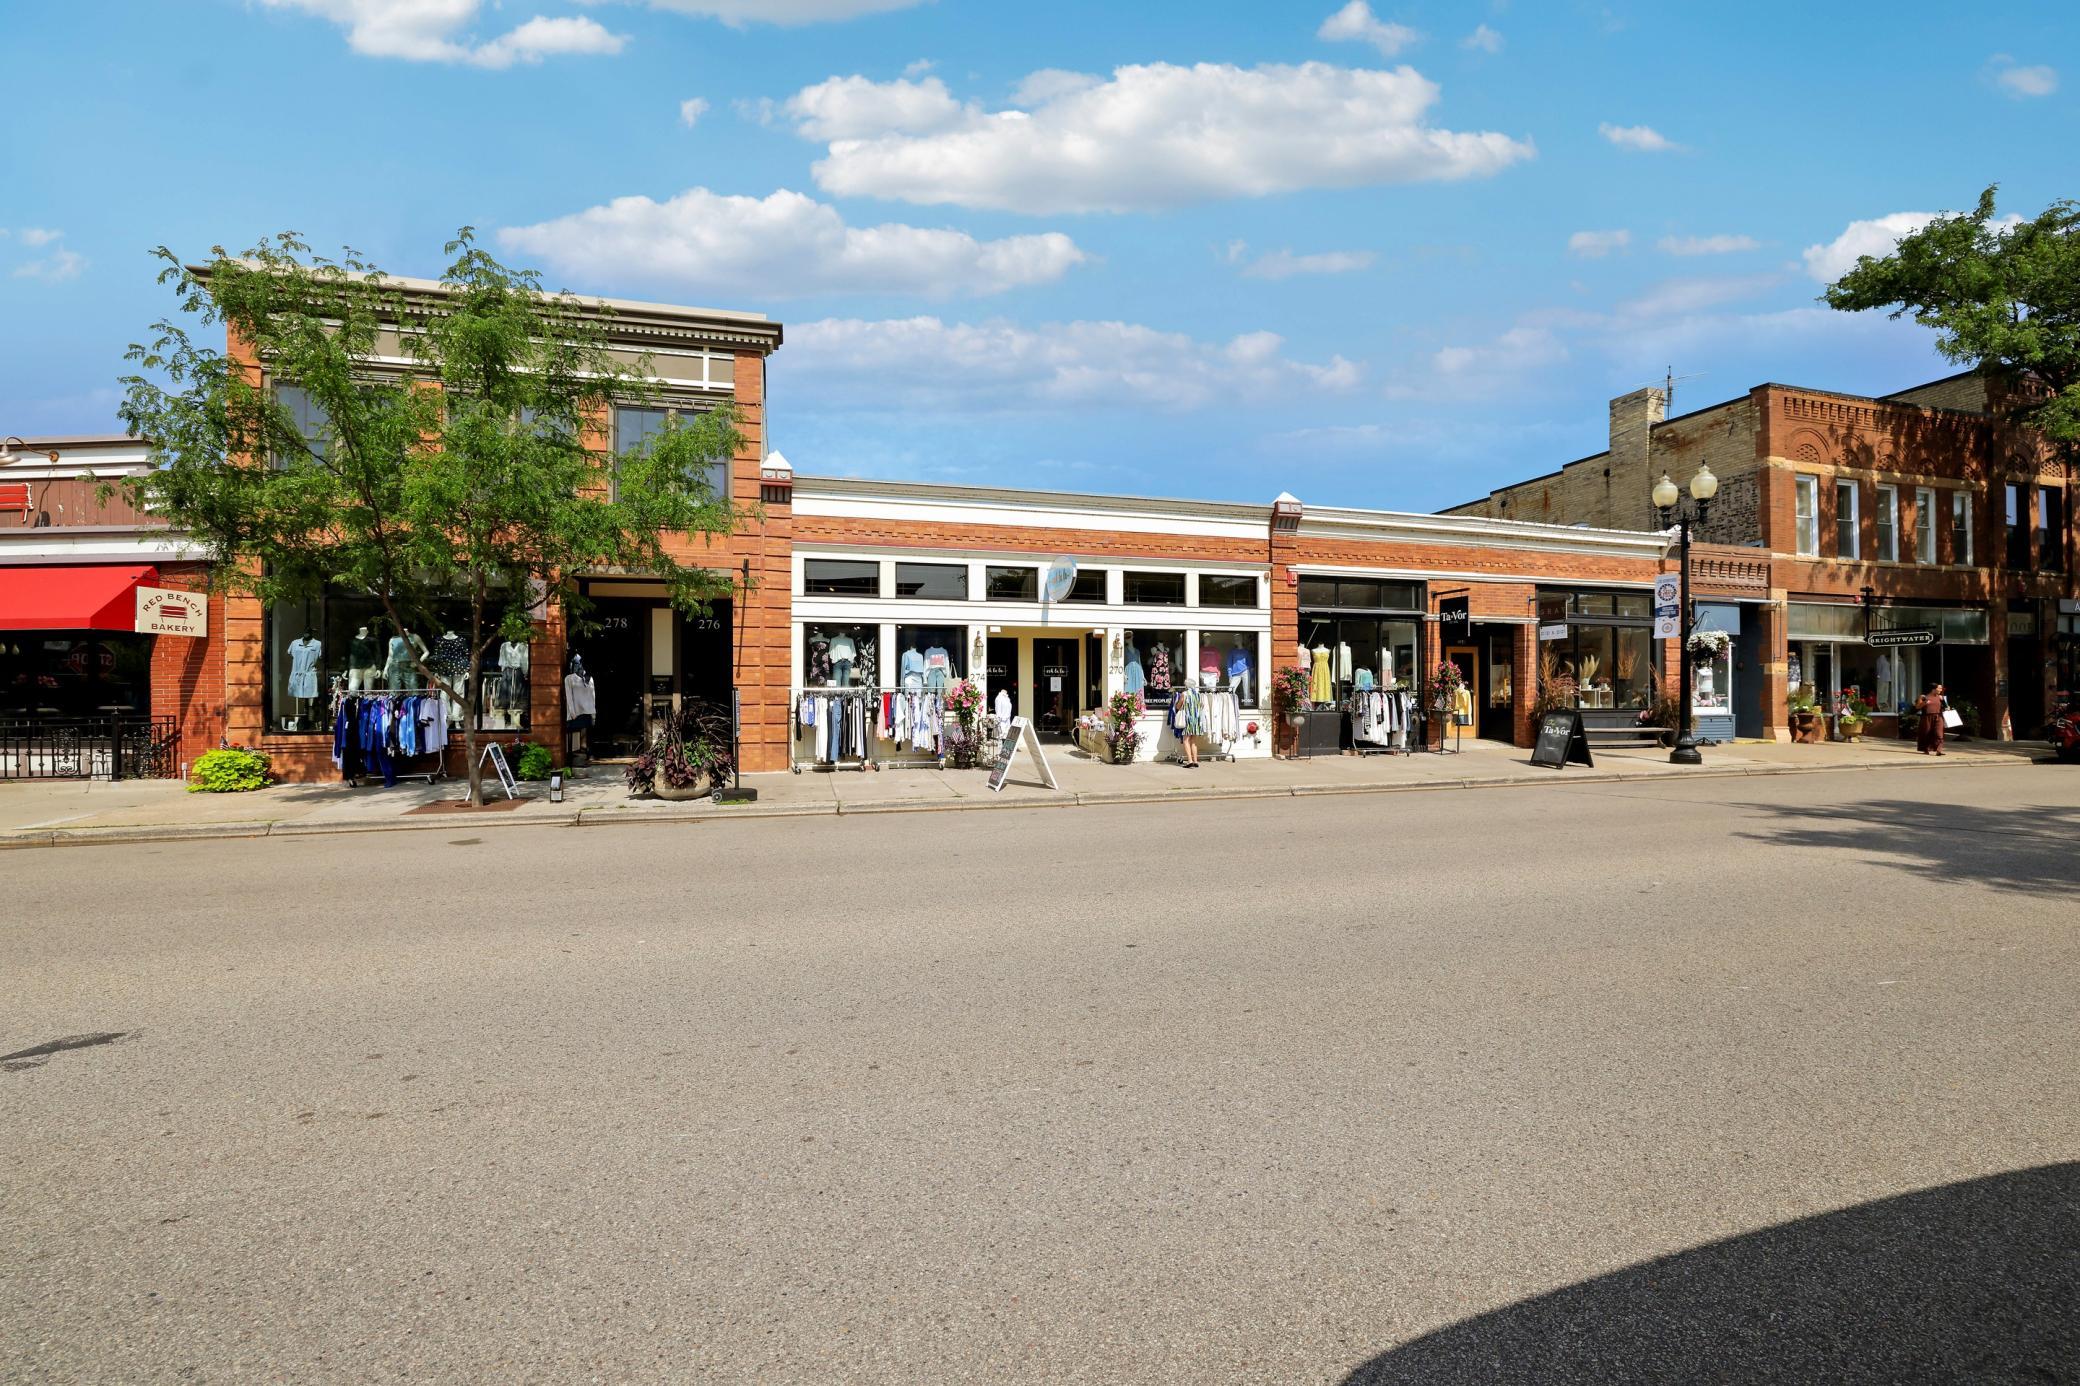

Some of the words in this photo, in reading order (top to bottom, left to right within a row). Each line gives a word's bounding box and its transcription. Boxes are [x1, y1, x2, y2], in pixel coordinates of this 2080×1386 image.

[142, 595, 163, 612] RED
[167, 593, 203, 617] BENCH
[151, 623, 195, 632] BAKERY
[605, 618, 628, 628] 278
[698, 620, 720, 629] 276
[1870, 635, 1930, 643] BRIGHTWATER
[1109, 666, 1123, 674] 270
[970, 673, 985, 682] 274
